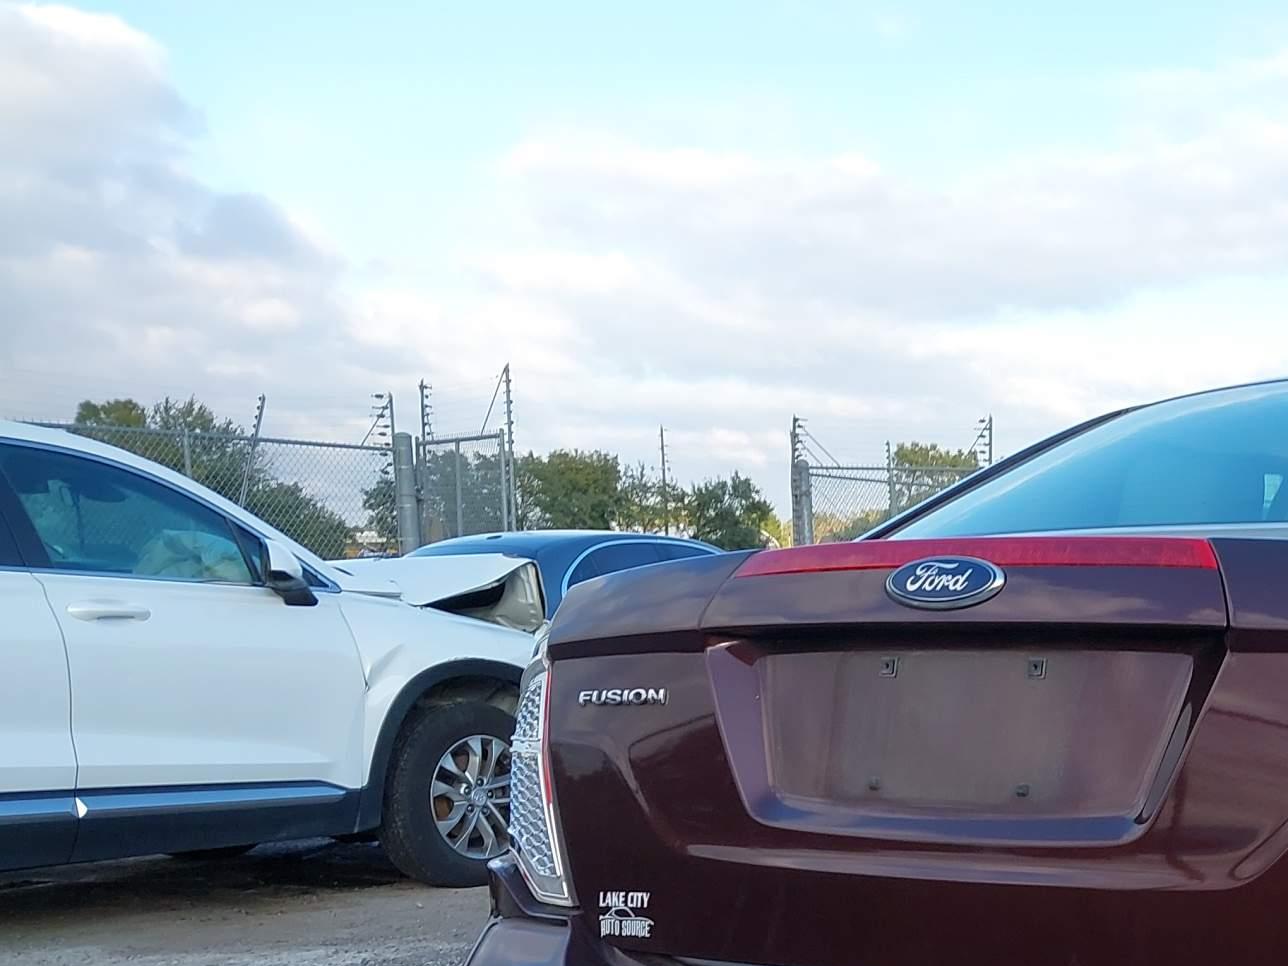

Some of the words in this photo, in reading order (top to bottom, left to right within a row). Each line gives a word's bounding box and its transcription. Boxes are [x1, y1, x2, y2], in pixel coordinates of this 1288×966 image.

[906, 561, 973, 592] Ford
[578, 688, 669, 706] FUSION
[599, 891, 626, 908] LAKE
[627, 892, 651, 909] CITY
[600, 920, 620, 938] AUTO
[621, 920, 651, 938] SOURCE
